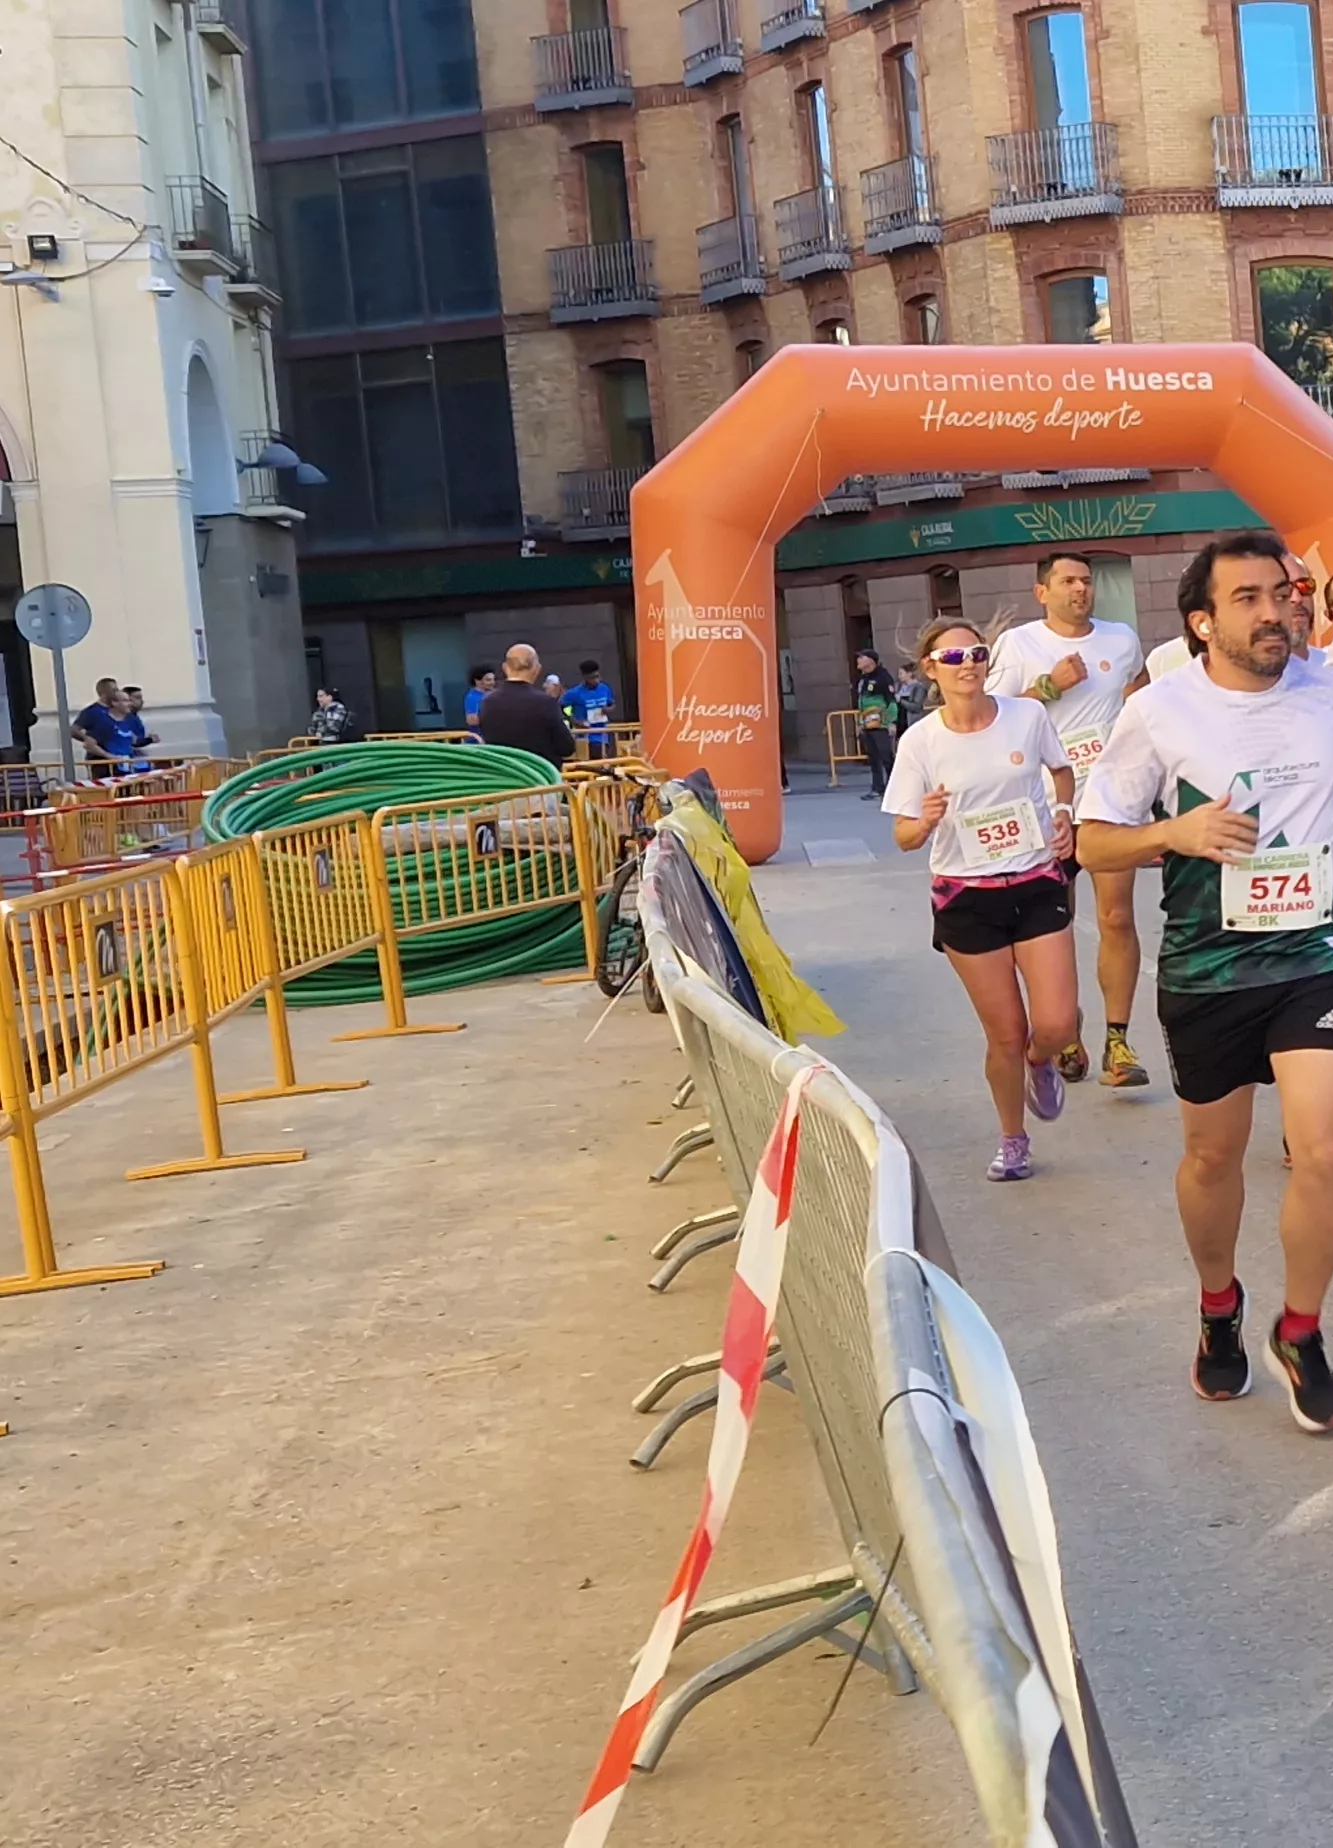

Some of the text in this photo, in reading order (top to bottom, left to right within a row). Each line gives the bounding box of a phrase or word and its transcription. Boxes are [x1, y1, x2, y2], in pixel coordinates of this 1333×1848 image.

[846, 367, 1213, 398] Ayuntamiento de Huesca
[919, 397, 1143, 440] Hacemos deporte
[647, 602, 765, 624] Ayuntamiento
[648, 624, 742, 640] de Huesca
[674, 695, 761, 721] Hacemos
[677, 719, 754, 754] deporte
[1067, 739, 1103, 761] 536
[717, 788, 764, 798] tamiento
[977, 820, 1020, 844] 538
[986, 839, 1019, 853] JOANA
[1250, 872, 1312, 900] 574
[1247, 900, 1314, 914] MARIANO
[1258, 915, 1279, 927] 8K
